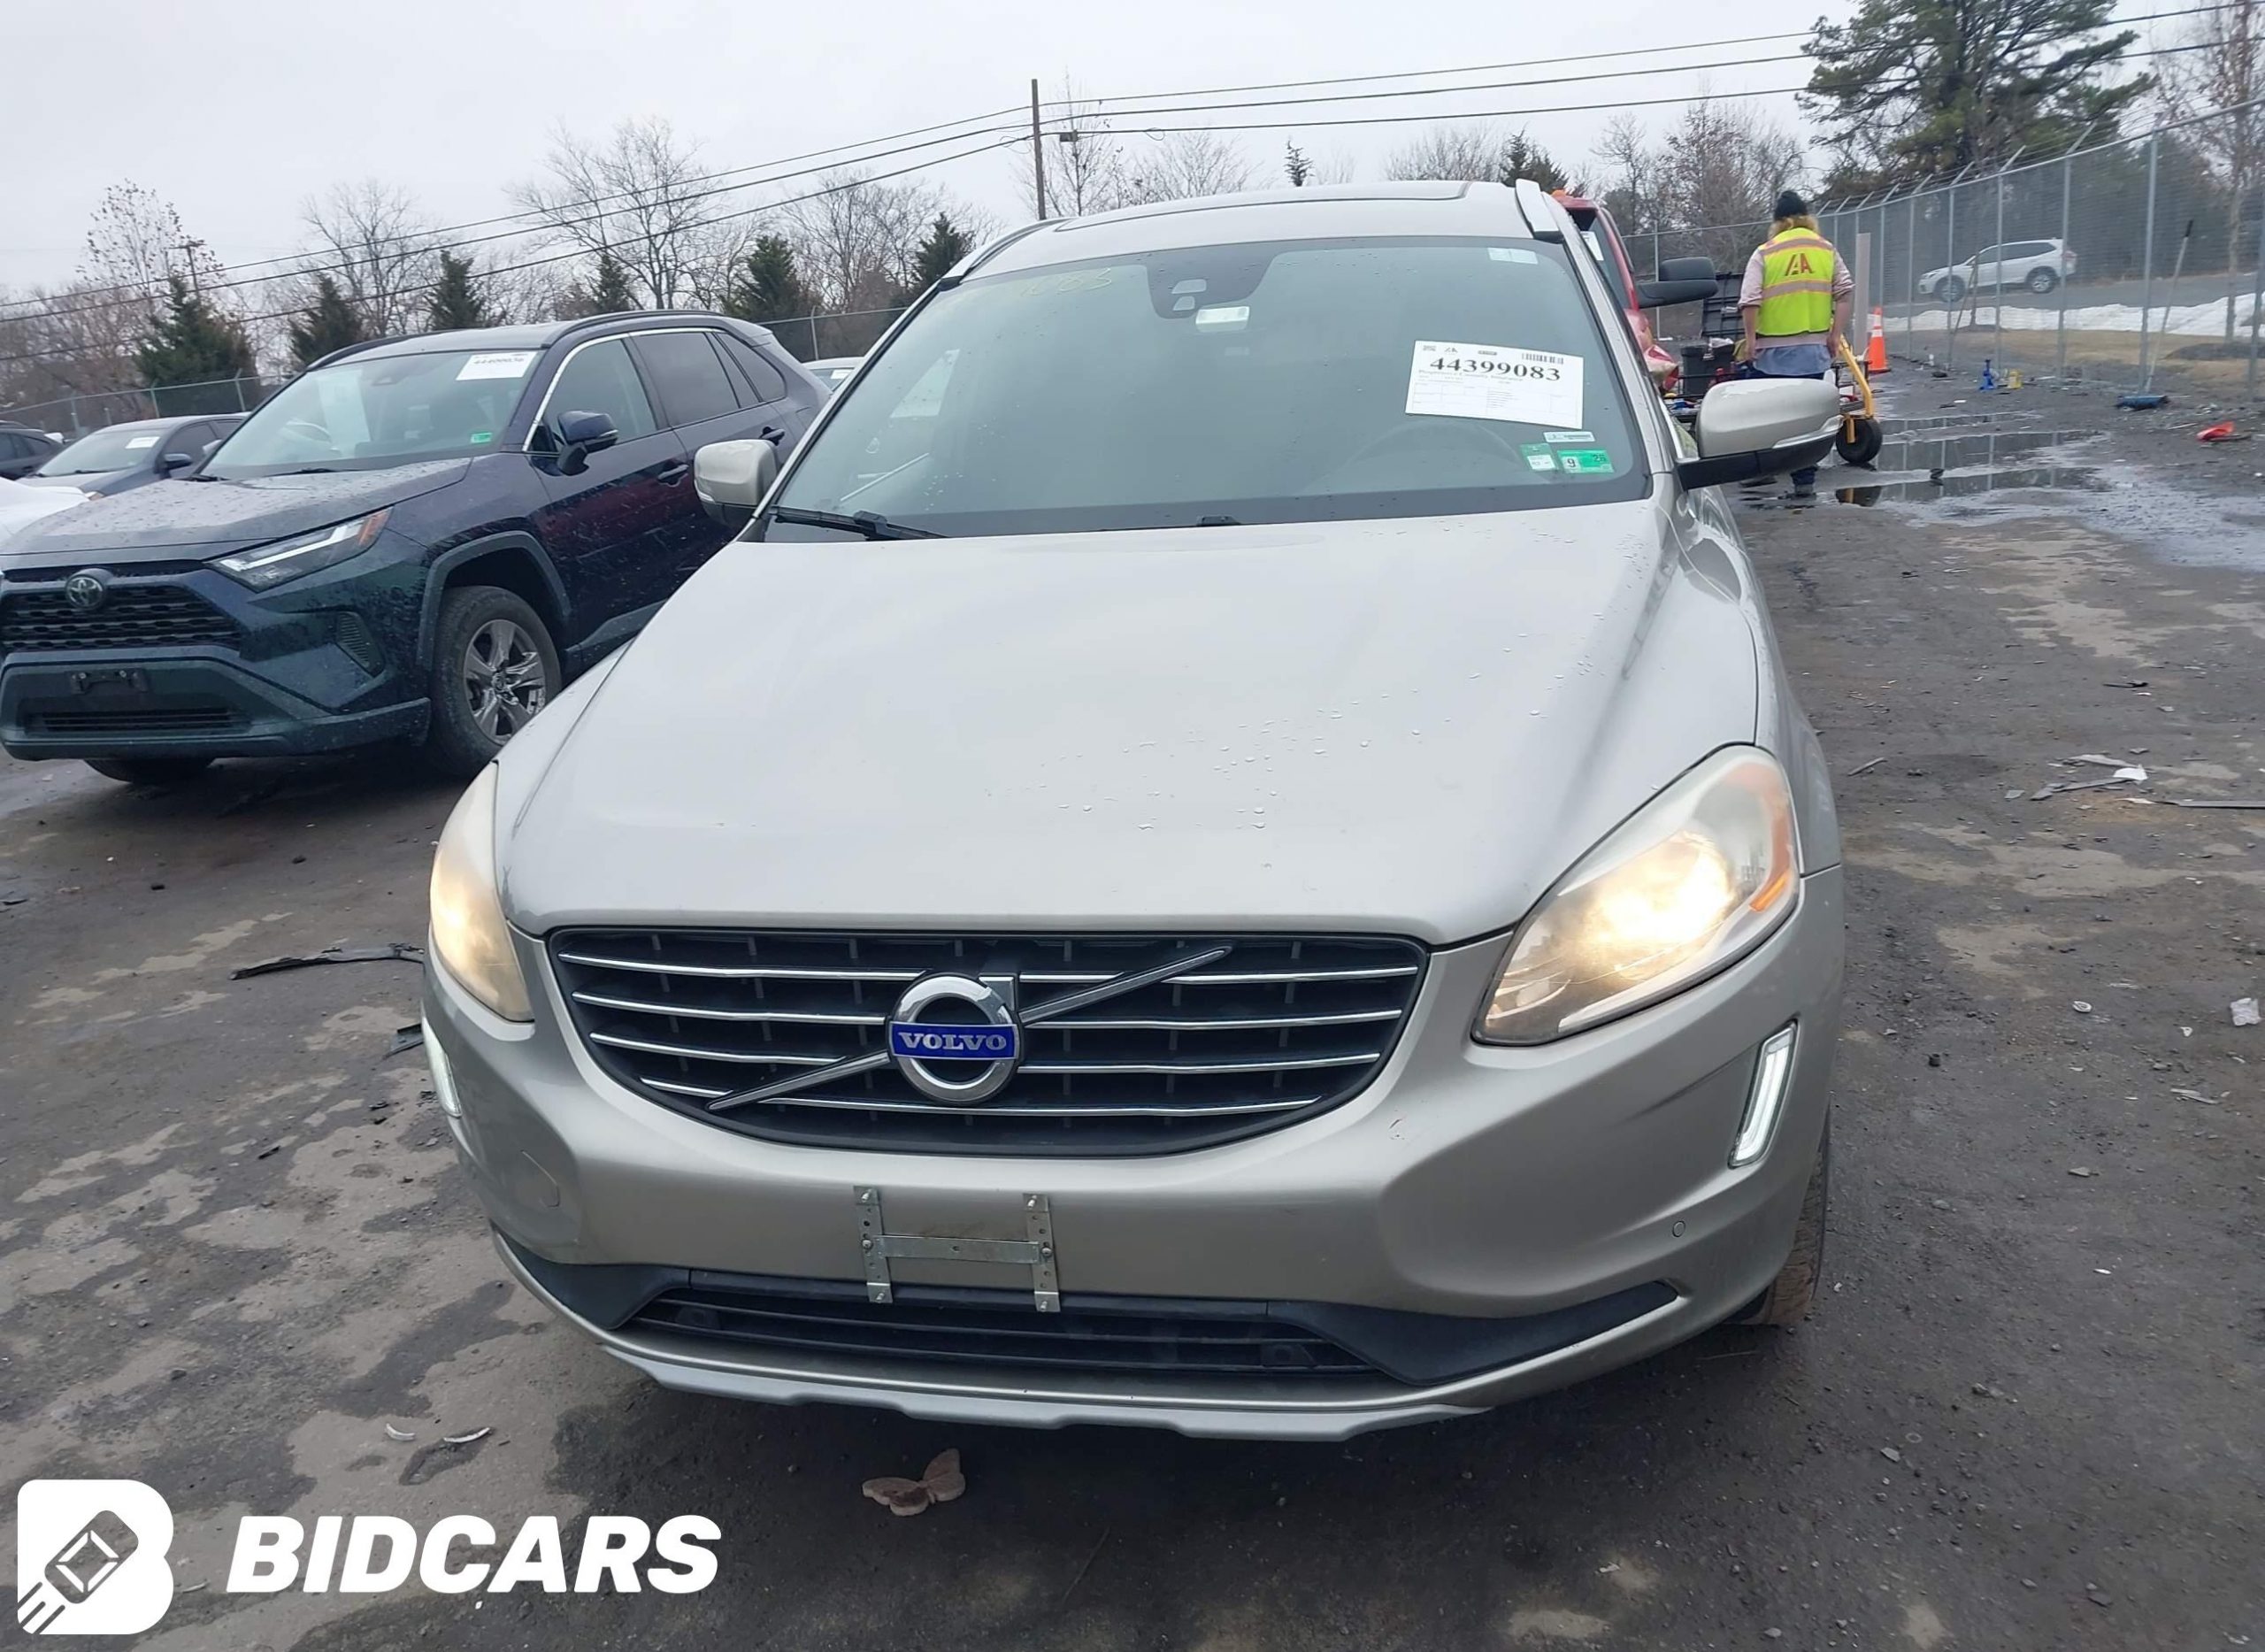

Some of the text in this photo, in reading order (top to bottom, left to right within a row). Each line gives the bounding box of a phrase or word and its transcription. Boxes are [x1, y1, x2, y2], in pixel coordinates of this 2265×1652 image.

[1430, 357, 1561, 381] 44399083
[1567, 458, 1577, 468] 9
[898, 1032, 1007, 1050] VOLVO
